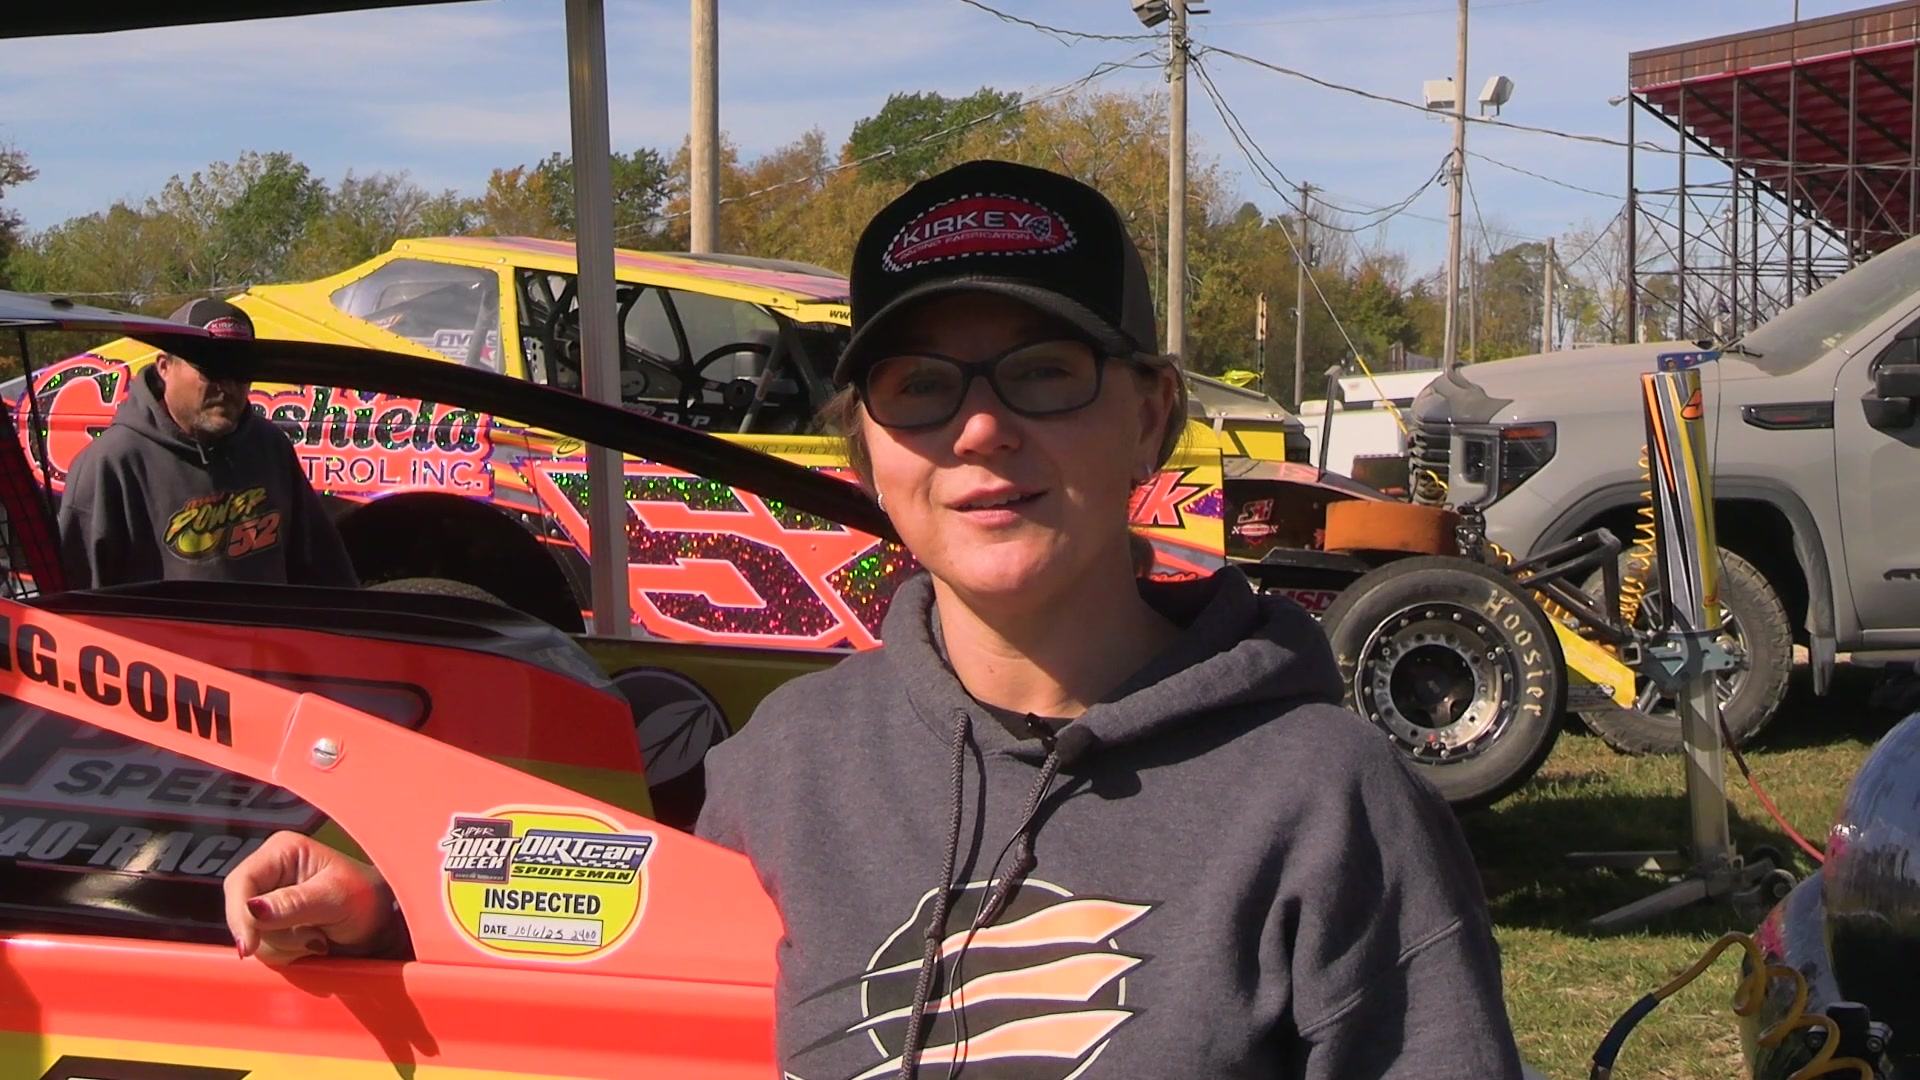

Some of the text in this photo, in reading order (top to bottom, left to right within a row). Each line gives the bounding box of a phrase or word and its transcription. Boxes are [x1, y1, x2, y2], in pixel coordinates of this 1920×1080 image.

[902, 211, 1031, 248] KIRKEY
[435, 333, 476, 348] FIV
[411, 459, 482, 488] INC.
[227, 512, 281, 557] 52
[0, 615, 233, 748] G.COM
[54, 759, 300, 810] SPEED
[450, 837, 521, 857] DIRT
[446, 856, 506, 870] WEEK
[512, 865, 631, 881] SPORTSMAN
[484, 888, 601, 915] INSPECTED
[483, 924, 508, 935] DATE
